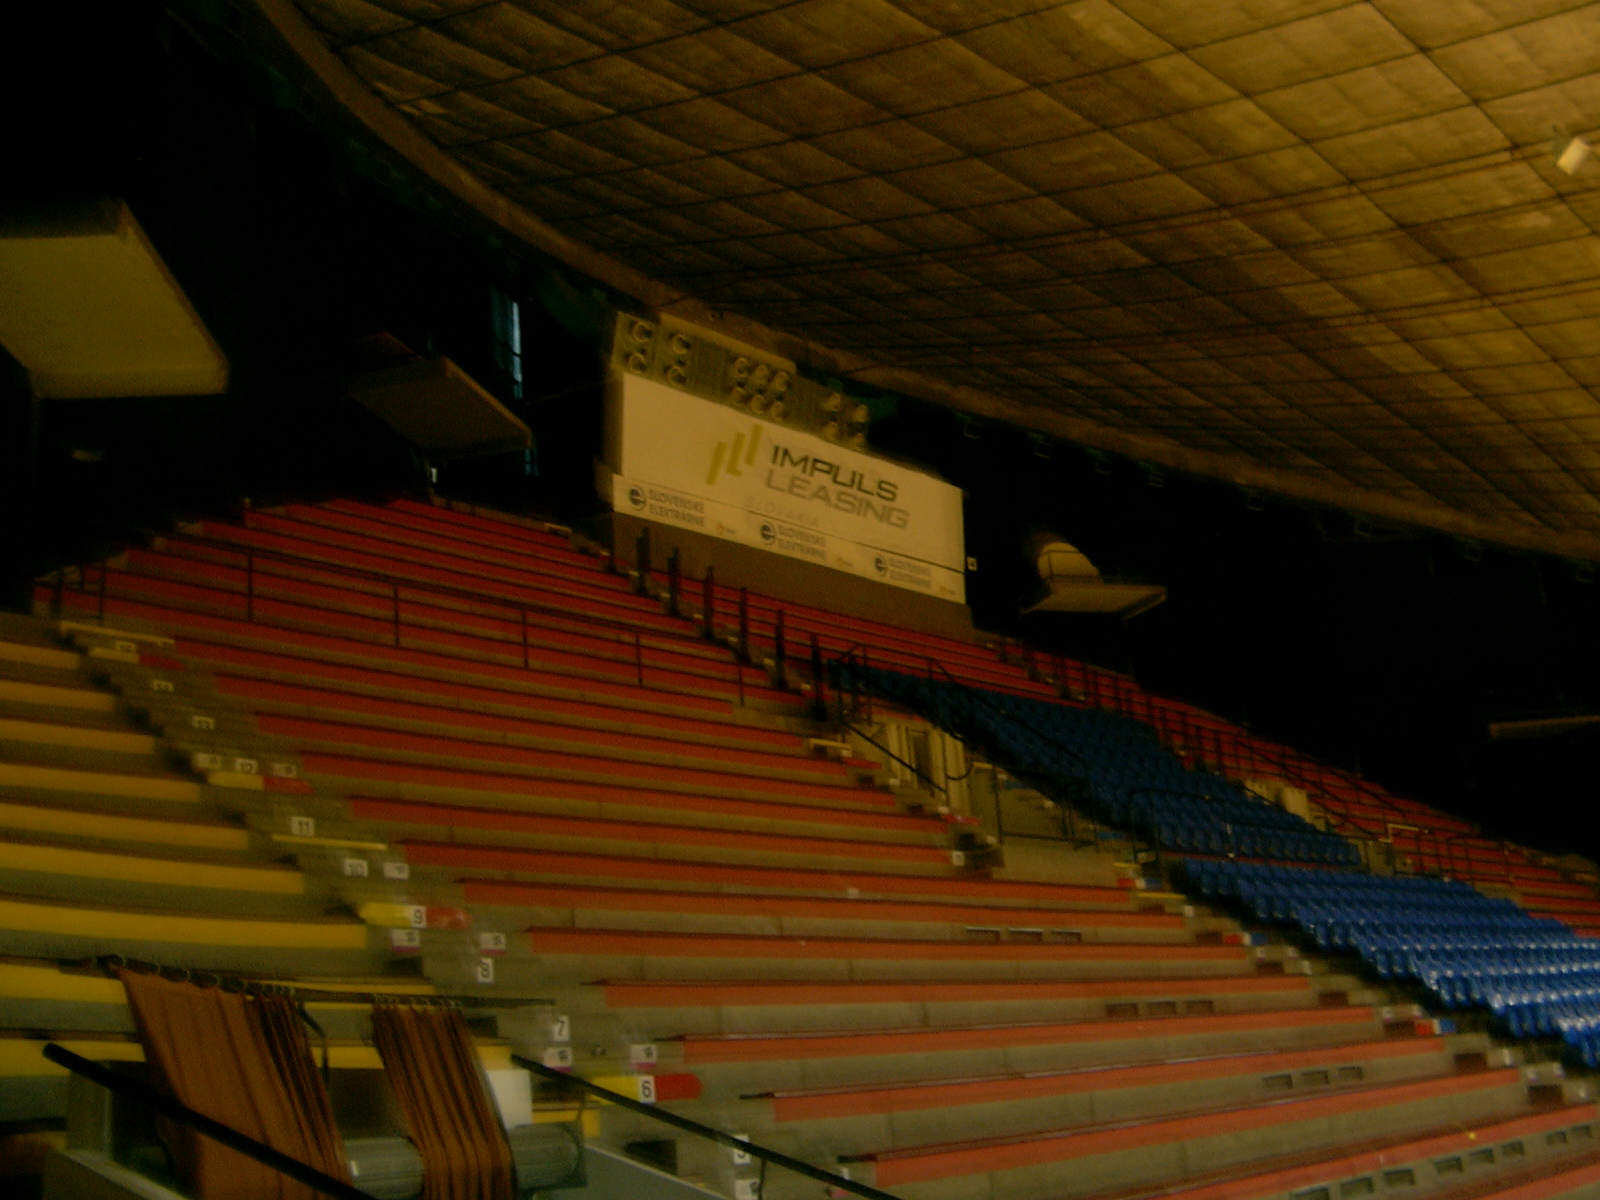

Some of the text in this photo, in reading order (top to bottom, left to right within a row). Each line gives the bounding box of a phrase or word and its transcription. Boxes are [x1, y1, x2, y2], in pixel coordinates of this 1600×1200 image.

[770, 445, 898, 502] IMPULS
[765, 469, 910, 529] LEASING
[297, 820, 310, 834] 11
[413, 908, 423, 925] 9
[556, 1017, 566, 1037] 7
[641, 1080, 652, 1098] 6
